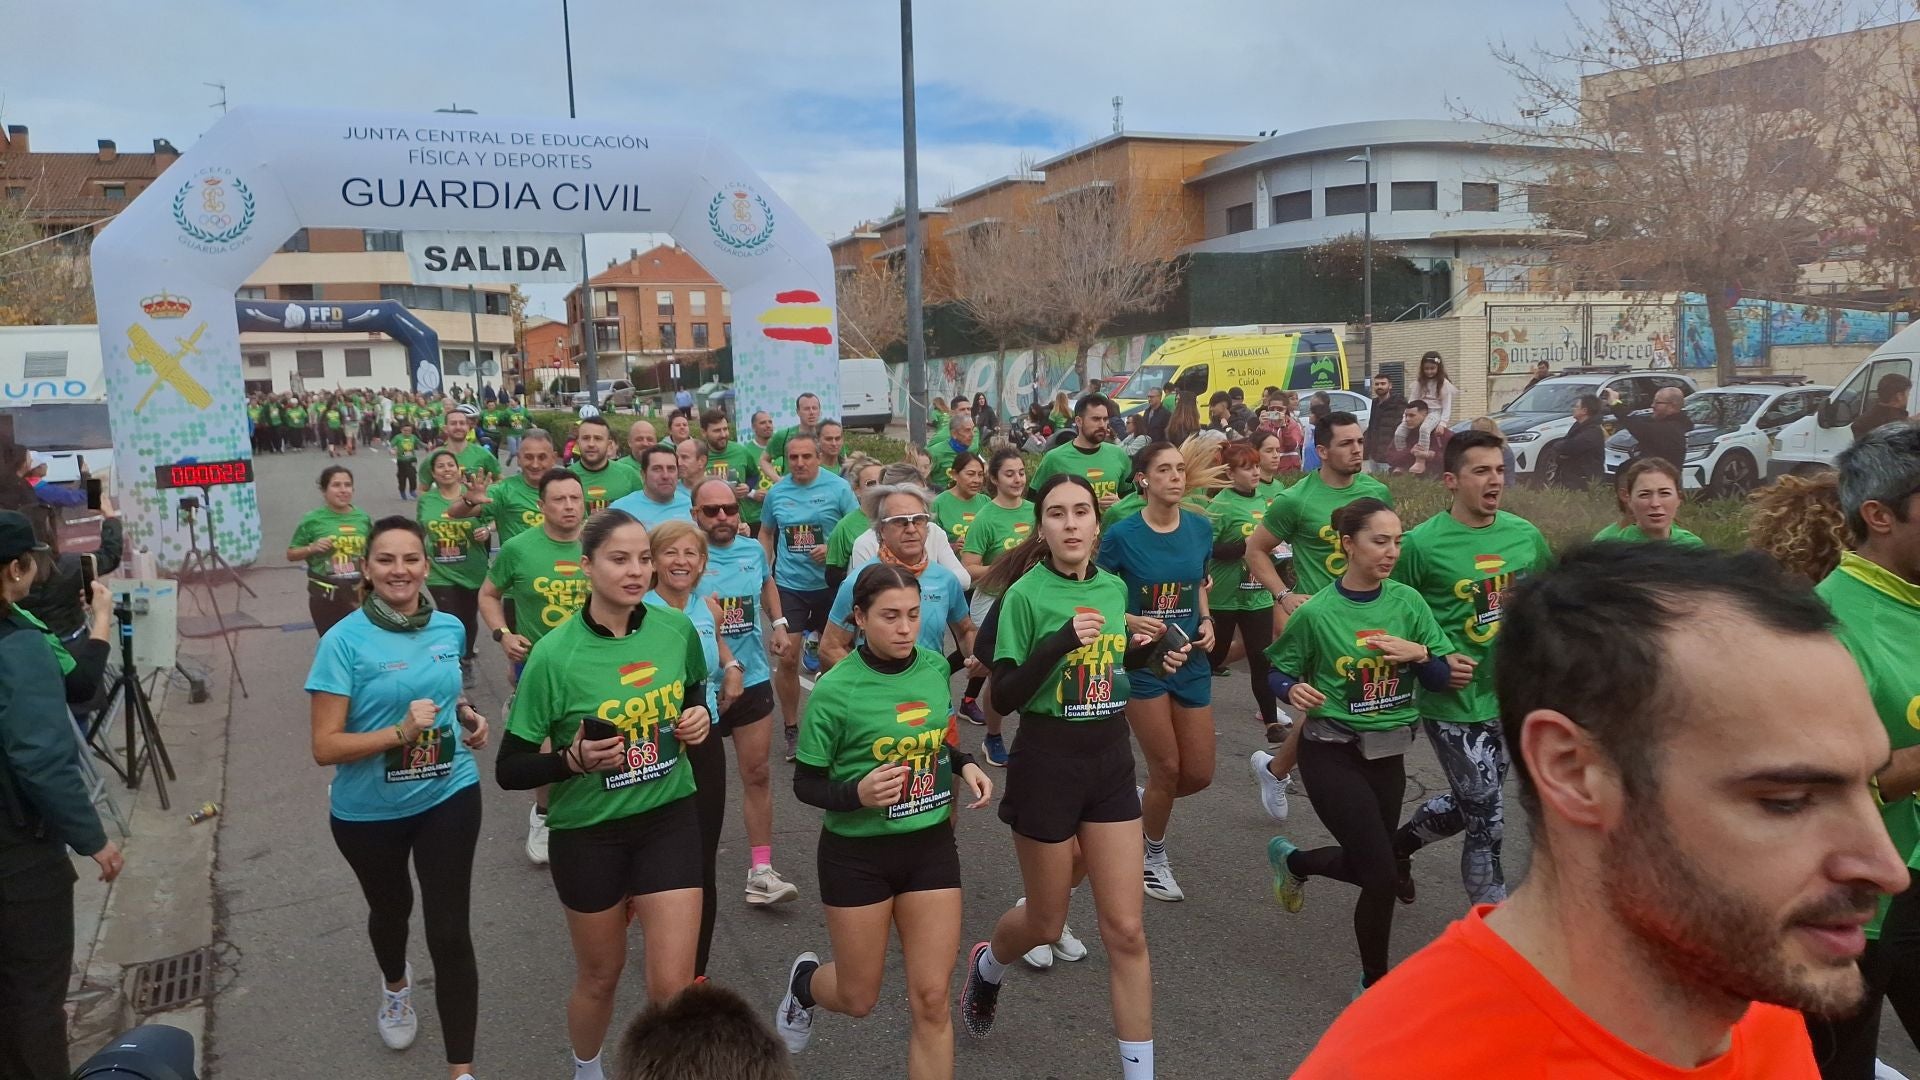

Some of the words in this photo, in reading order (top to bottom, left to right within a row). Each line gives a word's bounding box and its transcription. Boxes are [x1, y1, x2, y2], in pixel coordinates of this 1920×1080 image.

[343, 126, 409, 141] JUNTA
[415, 128, 505, 144] CENTRAL
[512, 132, 536, 146] DE
[542, 134, 649, 150] EDUCACIÓN
[408, 146, 470, 166] FÍSICA
[474, 152, 488, 166] Y
[494, 152, 592, 169] DEPORTES
[341, 176, 542, 210] GUARDIA
[552, 182, 652, 212] CIVIL
[424, 246, 567, 272] SALIDA
[309, 306, 343, 322] FFD
[1222, 347, 1270, 358] AMBULANCIA
[1593, 334, 1652, 361] Berceo
[1238, 378, 1260, 386] Cuida
[1248, 368, 1266, 376] Rioja
[1158, 594, 1178, 610] 97
[1086, 680, 1111, 702] 43
[1364, 678, 1399, 701] 217
[1381, 693, 1410, 703] SOLIDARIA
[410, 744, 436, 768] 21
[627, 742, 658, 769] 63
[391, 768, 421, 776] CARRERA
[610, 770, 642, 782] CARRERA
[610, 778, 641, 789] GUARDIA
[643, 772, 660, 780] CIVIL
[910, 774, 934, 798] 42
[892, 800, 920, 811] CARRERA
[921, 790, 950, 804] SOLIDARIA
[892, 808, 918, 817] GUARDIA
